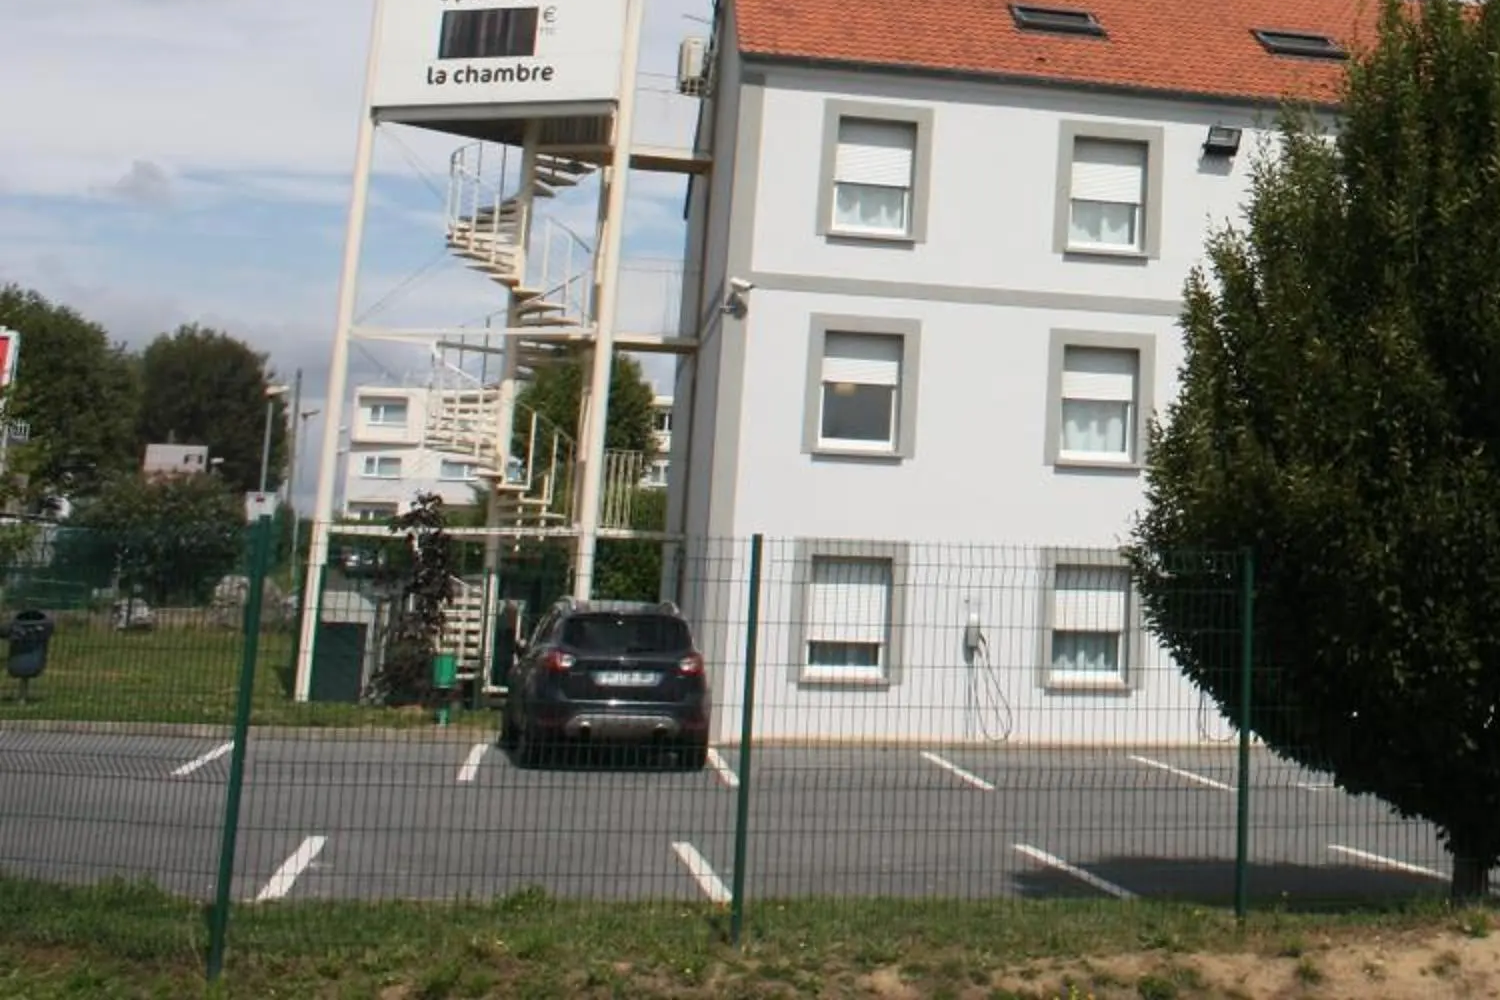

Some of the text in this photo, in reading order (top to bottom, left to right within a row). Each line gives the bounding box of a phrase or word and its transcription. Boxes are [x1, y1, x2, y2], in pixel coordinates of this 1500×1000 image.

[543, 5, 557, 23] €
[427, 63, 554, 85] la chambre
